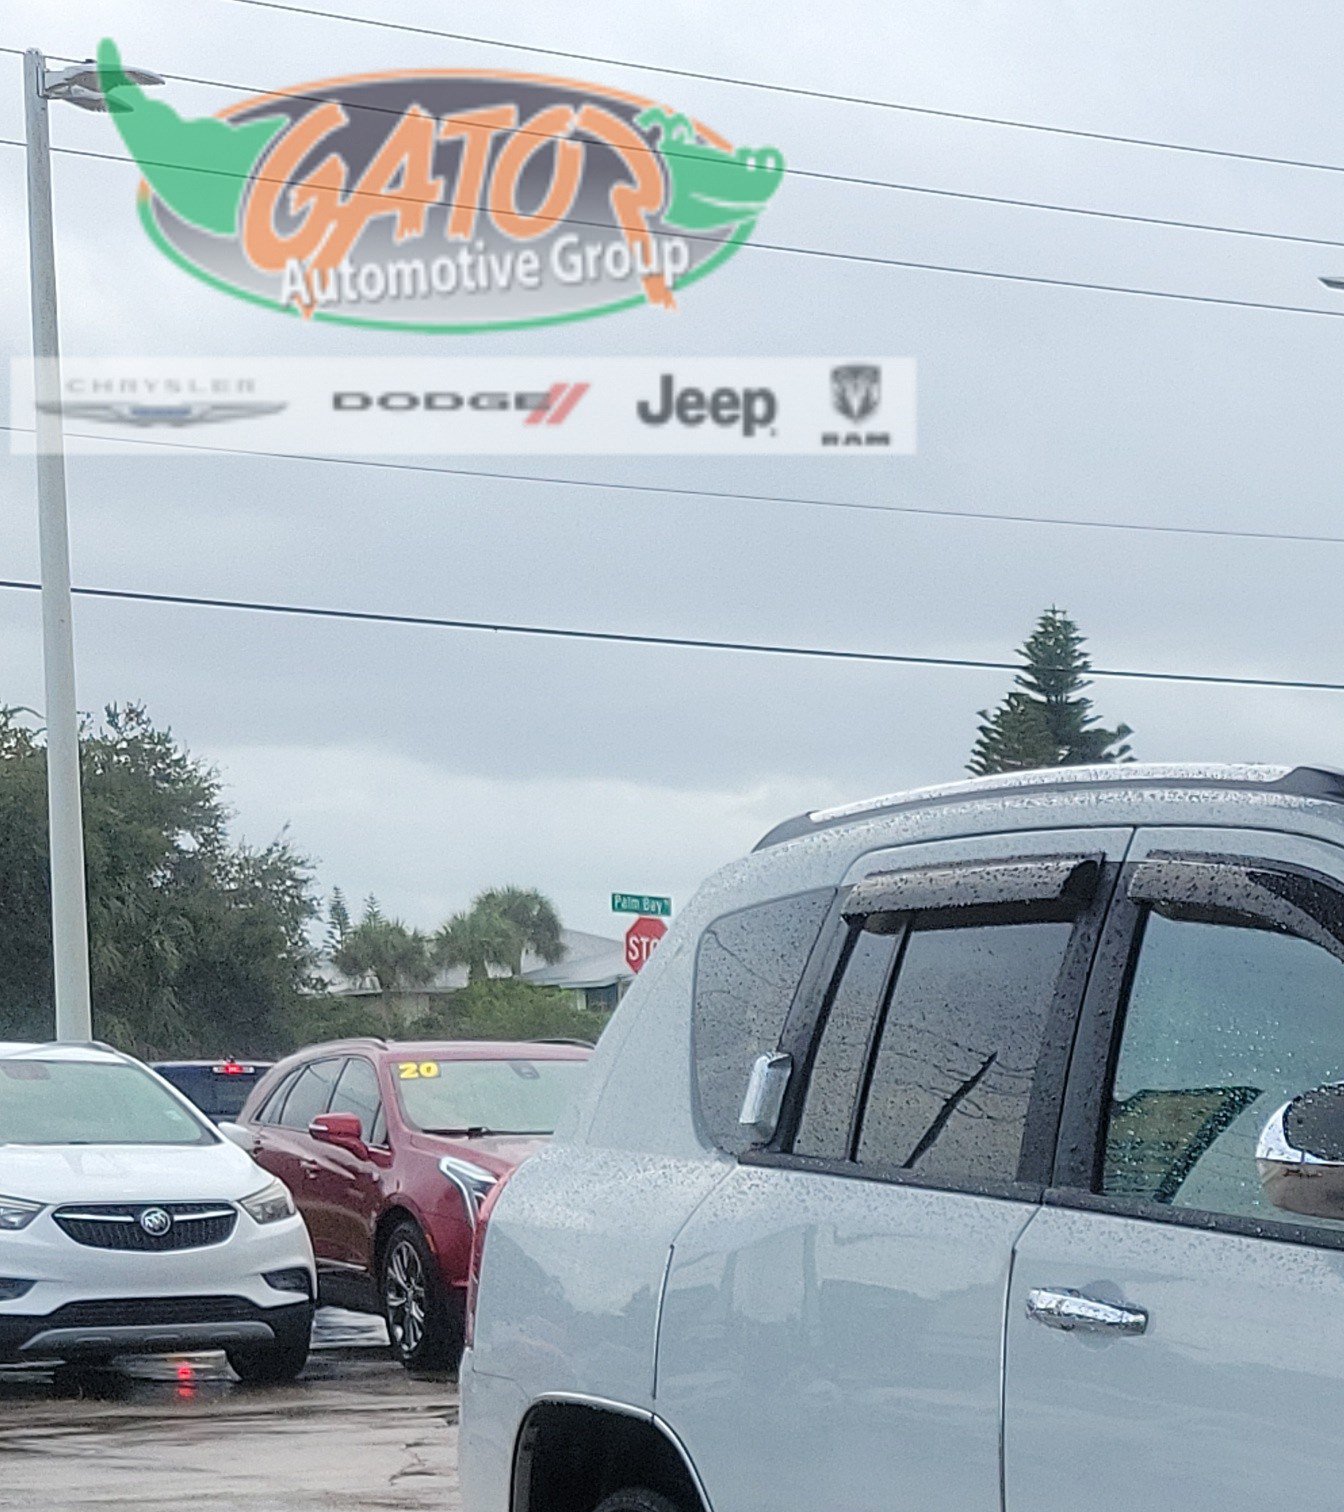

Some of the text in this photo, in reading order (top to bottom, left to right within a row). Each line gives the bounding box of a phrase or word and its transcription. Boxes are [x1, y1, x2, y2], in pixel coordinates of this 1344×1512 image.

[614, 894, 663, 914] Palm Bay
[399, 1062, 439, 1079] 20
